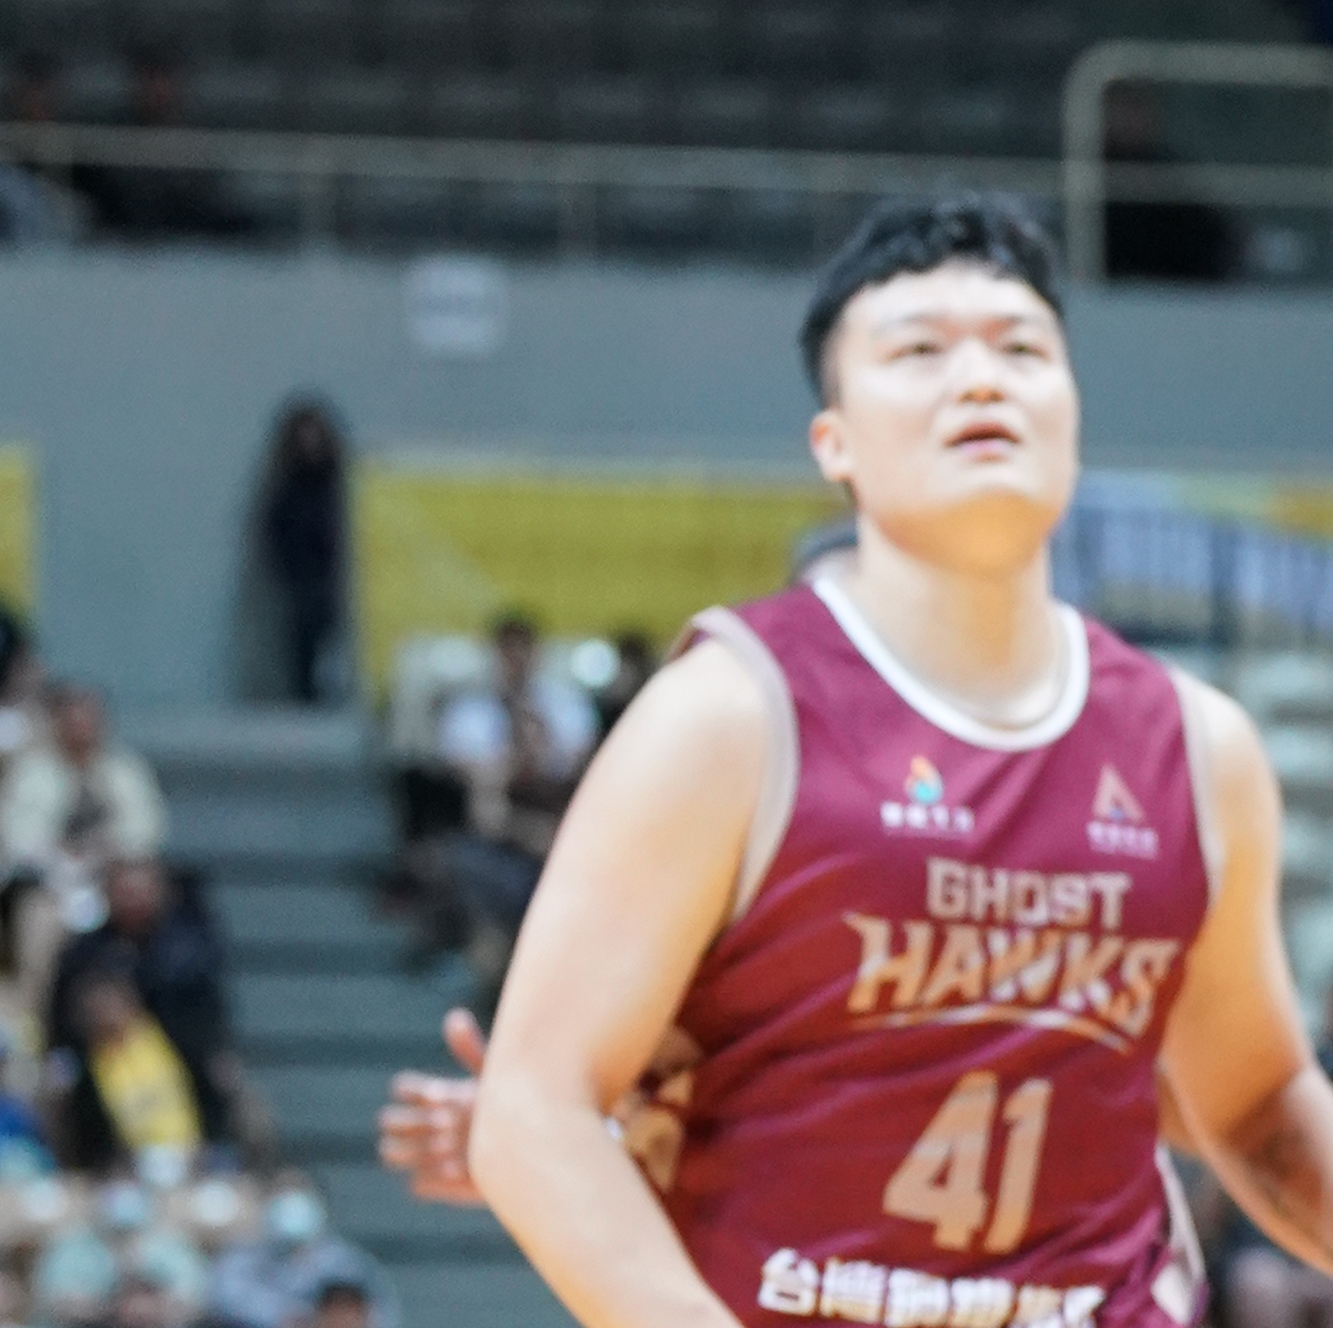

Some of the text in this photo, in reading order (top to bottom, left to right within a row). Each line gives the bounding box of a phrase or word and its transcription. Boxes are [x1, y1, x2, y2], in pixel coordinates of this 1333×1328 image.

[926, 857, 1132, 929] GHOST
[842, 911, 1180, 1038] HAWKS
[882, 1070, 1053, 1254] 41
